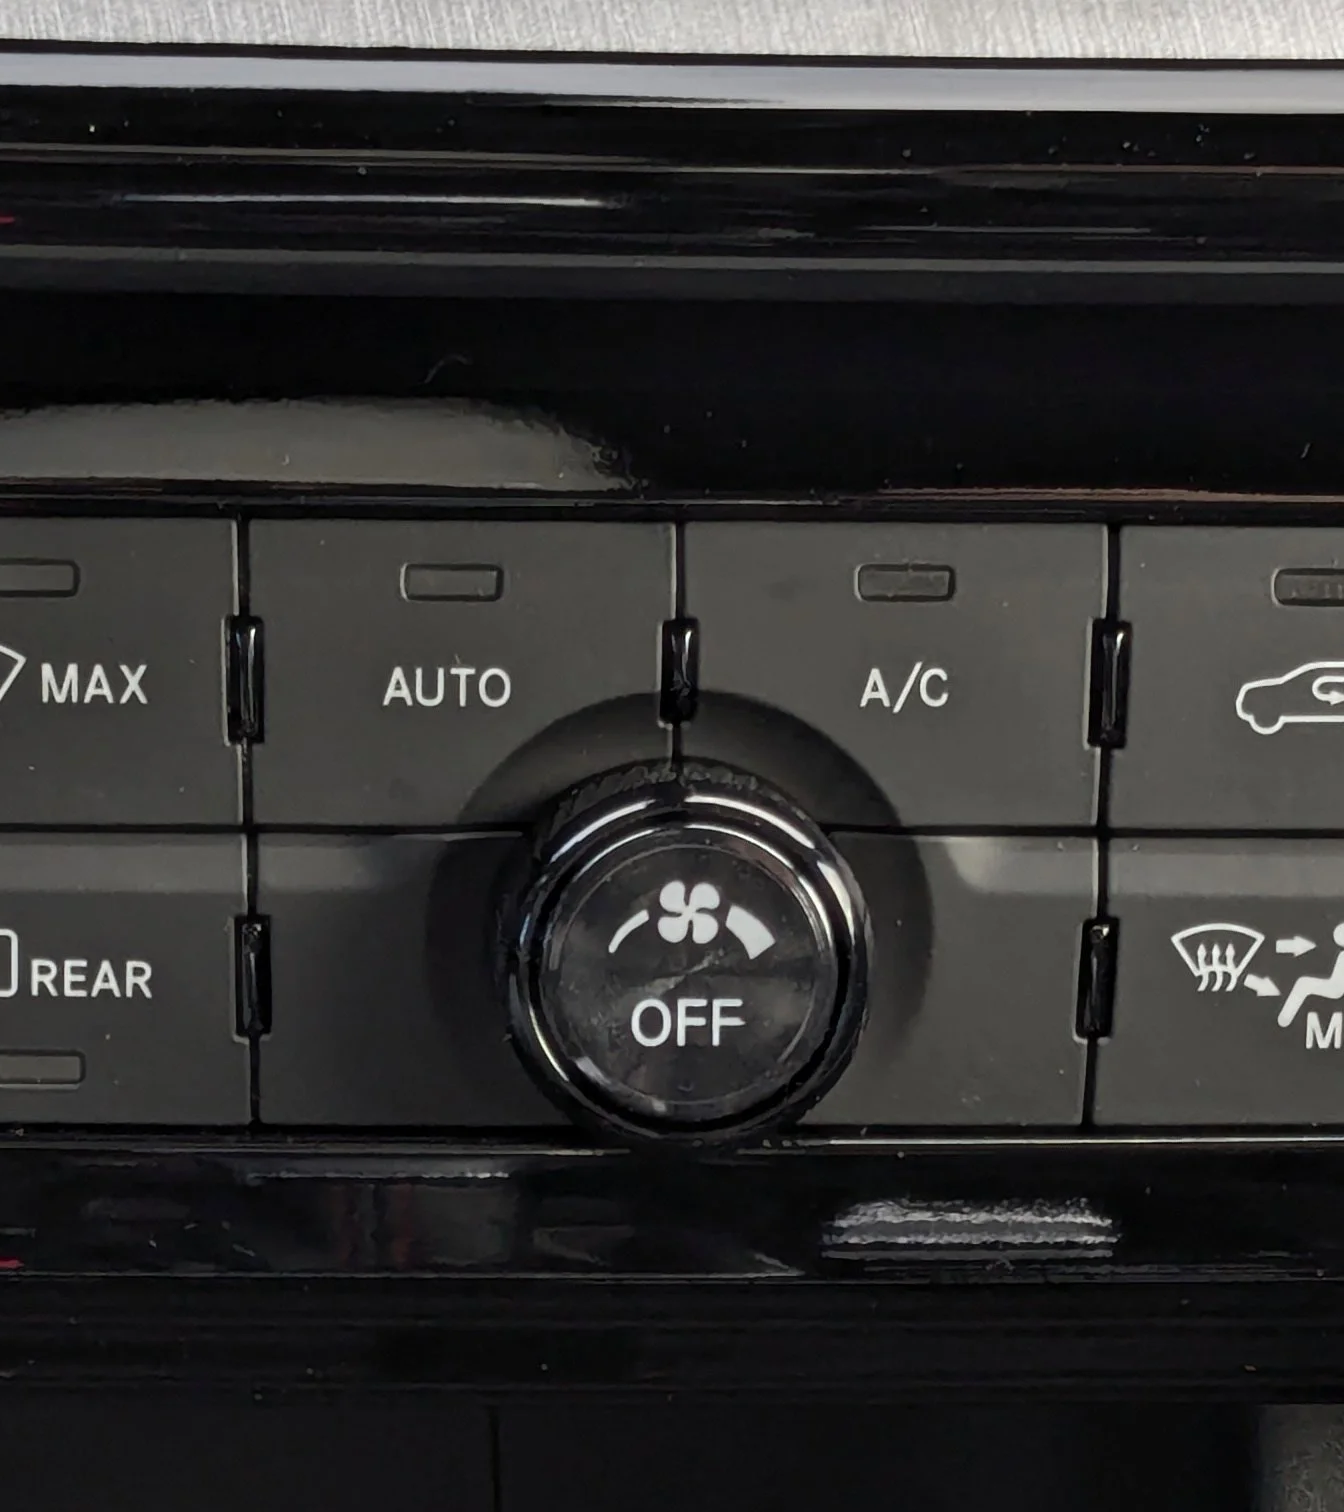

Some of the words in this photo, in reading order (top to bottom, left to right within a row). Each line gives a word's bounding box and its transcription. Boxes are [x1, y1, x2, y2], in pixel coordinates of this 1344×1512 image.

[40, 662, 148, 705] MAX
[382, 666, 512, 708] AUTO
[859, 661, 949, 713] A/C
[30, 958, 153, 999] REAR
[630, 995, 746, 1047] OFF
